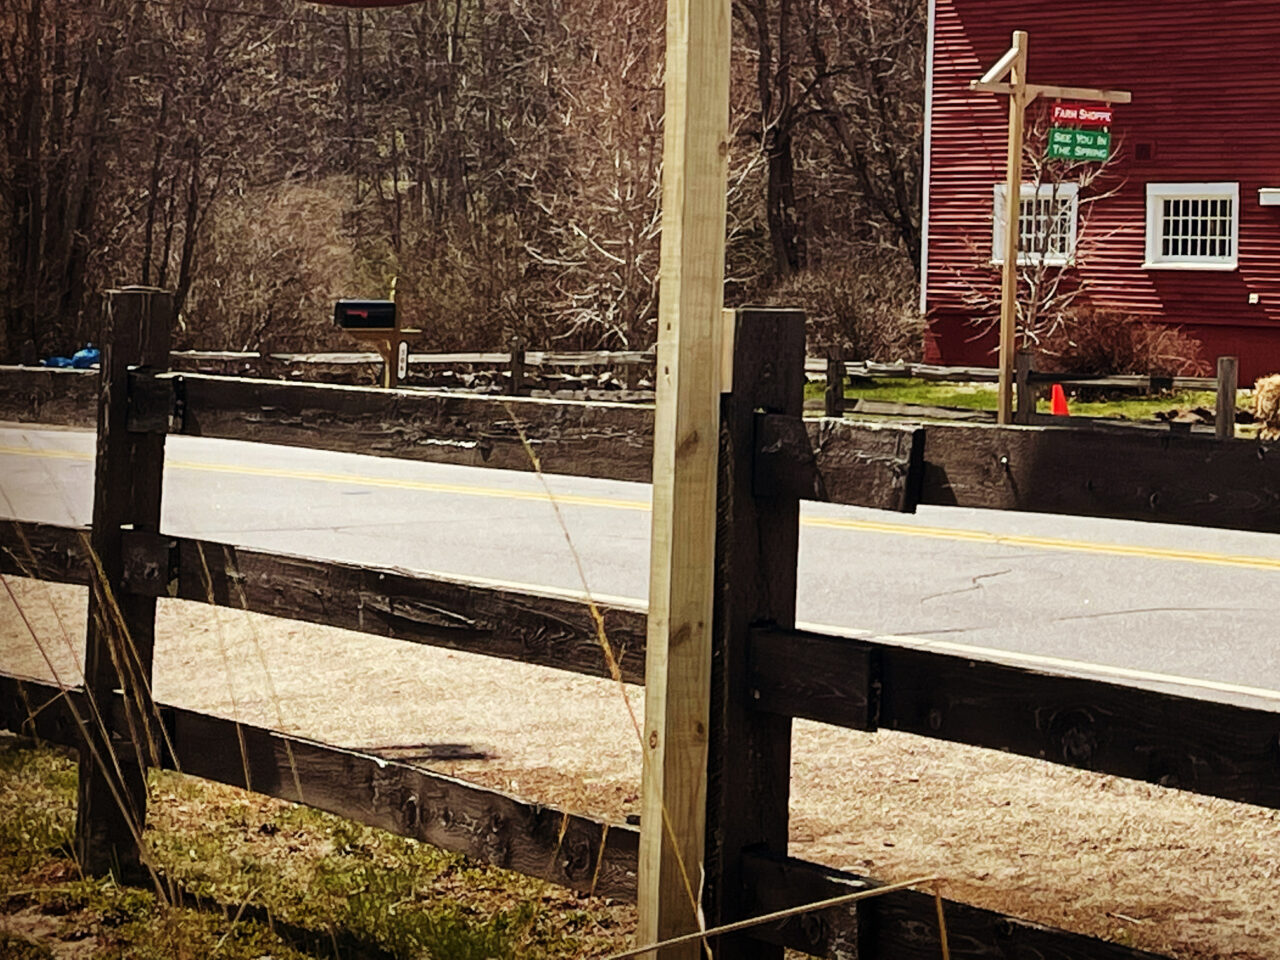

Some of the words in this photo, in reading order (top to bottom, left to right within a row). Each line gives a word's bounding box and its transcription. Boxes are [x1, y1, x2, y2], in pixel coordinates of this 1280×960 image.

[1054, 107, 1077, 119] FARM
[1079, 109, 1111, 122] SHOPPE
[1053, 132, 1072, 143] SEE
[1076, 134, 1093, 145] YOU
[1097, 135, 1107, 145] IN
[1053, 145, 1071, 155] THE
[1074, 146, 1107, 158] SPRING
